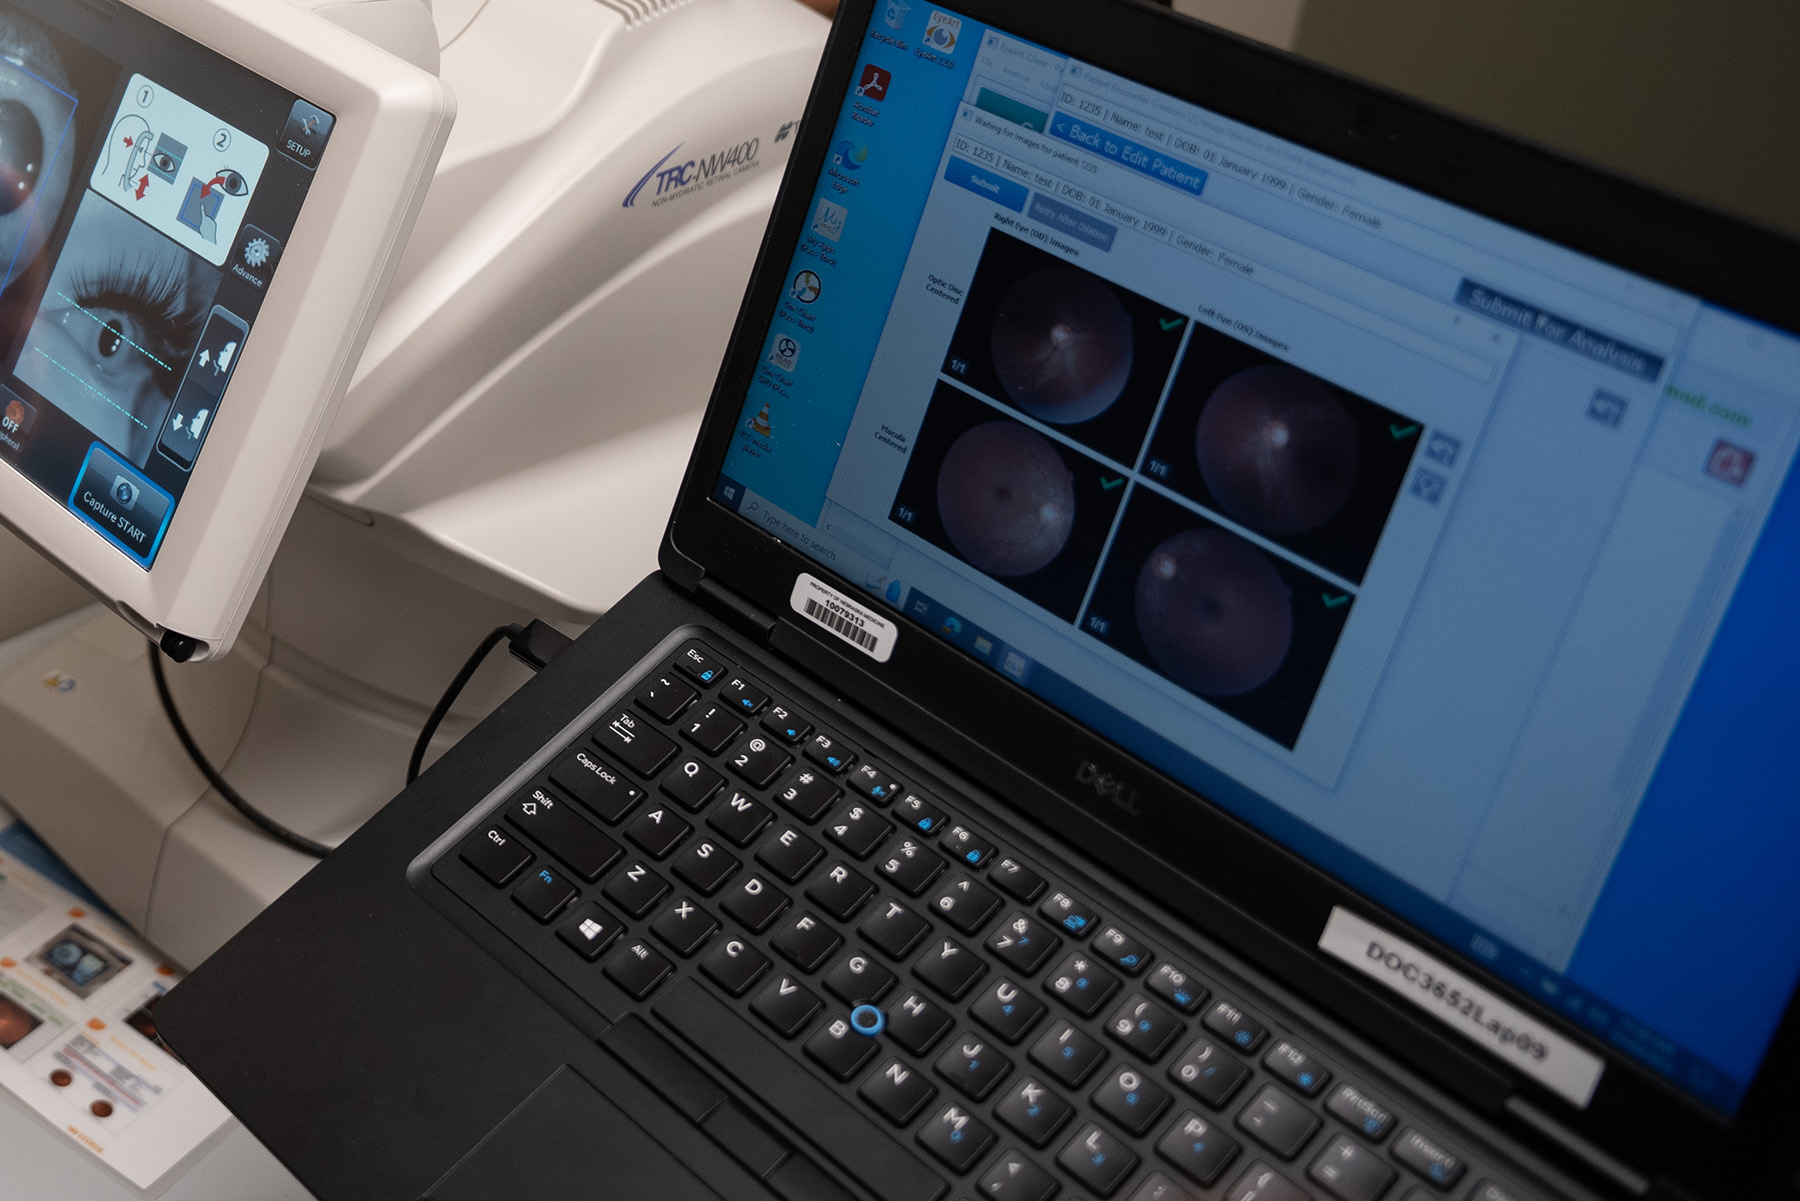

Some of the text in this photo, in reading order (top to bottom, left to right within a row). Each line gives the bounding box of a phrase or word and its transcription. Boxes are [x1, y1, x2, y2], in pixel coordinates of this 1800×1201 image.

[933, 12, 961, 29] EyeArt
[870, 29, 908, 51] Recycle Bin
[913, 48, 954, 69] EyeArt 2.2.0
[980, 56, 1030, 82] File Analyze
[853, 101, 880, 117] Acrobat
[852, 111, 875, 127] Reader
[286, 139, 311, 158] SETUP
[975, 115, 1001, 135] Waiting
[1002, 127, 1014, 140] for
[1041, 143, 1053, 154] for
[1052, 150, 1079, 167] patient
[1080, 159, 1098, 174] 1235
[1060, 91, 1381, 229] ID: 1235 Name: test DOB: 01 January 1999 Gender: Female
[1069, 124, 1100, 149] Back
[1104, 139, 1117, 155] to
[1121, 145, 1148, 169] Edit
[1151, 158, 1201, 190] Patient
[652, 161, 759, 207] NON-MYDRIATIC RETINAL CAMERA
[828, 168, 860, 187] Microsoft
[970, 174, 1000, 194] Submit
[831, 181, 848, 194] Edge
[954, 138, 1254, 275] ID: 1235 Name: test DOB: 01 January 1999 Gender: Female
[1033, 202, 1109, 242] Retry After Dilation
[994, 212, 1079, 257] Right Eye (OD) Images
[232, 263, 263, 287] Advance
[925, 284, 960, 305] Centered
[928, 274, 964, 296] Optic Disc
[1197, 304, 1215, 318] Left
[1216, 313, 1232, 326] Eye
[1254, 330, 1288, 351] Images
[1471, 288, 1531, 325] Submit
[1569, 327, 1646, 373] Analysis
[951, 358, 967, 374] 1/1
[2, 416, 19, 433] OFF
[880, 424, 906, 442] Macula
[874, 431, 907, 454] Centered
[1150, 460, 1167, 476] 1/1
[83, 491, 146, 543] Capture START
[898, 507, 913, 521] 1/1
[763, 510, 837, 560] Type here to search
[810, 581, 833, 598] PROPERTY
[840, 599, 864, 615] NEBRASKA
[863, 612, 885, 629] MEDICINE
[825, 600, 865, 627] 10079313
[1090, 616, 1106, 633] 1/1
[687, 648, 704, 663] Esc
[731, 678, 746, 691] F1
[619, 713, 635, 729] Tab
[773, 706, 789, 720] F2
[816, 735, 832, 749] F3
[576, 752, 617, 785] Caps Lock
[683, 762, 699, 778] Q
[861, 765, 877, 779] F4
[1073, 758, 1140, 816] DELL
[532, 790, 554, 809] Shift
[730, 792, 752, 813] W
[905, 795, 922, 811] F5
[648, 809, 664, 824] A
[487, 829, 506, 846] Ctrl
[779, 830, 799, 847] E
[952, 826, 971, 842] F6
[696, 843, 714, 859] S
[627, 864, 647, 882] Z
[829, 866, 848, 884] R
[1000, 859, 1020, 873] F7
[539, 869, 552, 884] Fn
[744, 878, 764, 895] D
[674, 900, 695, 920] X
[886, 902, 904, 919] T
[1052, 892, 1073, 910] F8
[796, 916, 816, 931] F
[1105, 928, 1126, 946] F9
[631, 943, 649, 960] Alt
[726, 940, 745, 958] C
[940, 942, 960, 959] Y
[849, 956, 869, 974] G
[1160, 964, 1187, 987] F10
[779, 977, 798, 997] V
[996, 983, 1019, 1003] U
[902, 995, 927, 1017] H
[1216, 1001, 1243, 1025] F11
[829, 1020, 849, 1039] B
[963, 1044, 983, 1059] J
[1277, 1043, 1306, 1065] F12
[885, 1063, 910, 1086] N
[1118, 1071, 1141, 1091] O
[1021, 1083, 1045, 1104] K
[942, 1106, 969, 1131] M
[1183, 1118, 1207, 1137] P
[1085, 1130, 1101, 1149] L
[1410, 1133, 1456, 1167] Insert
